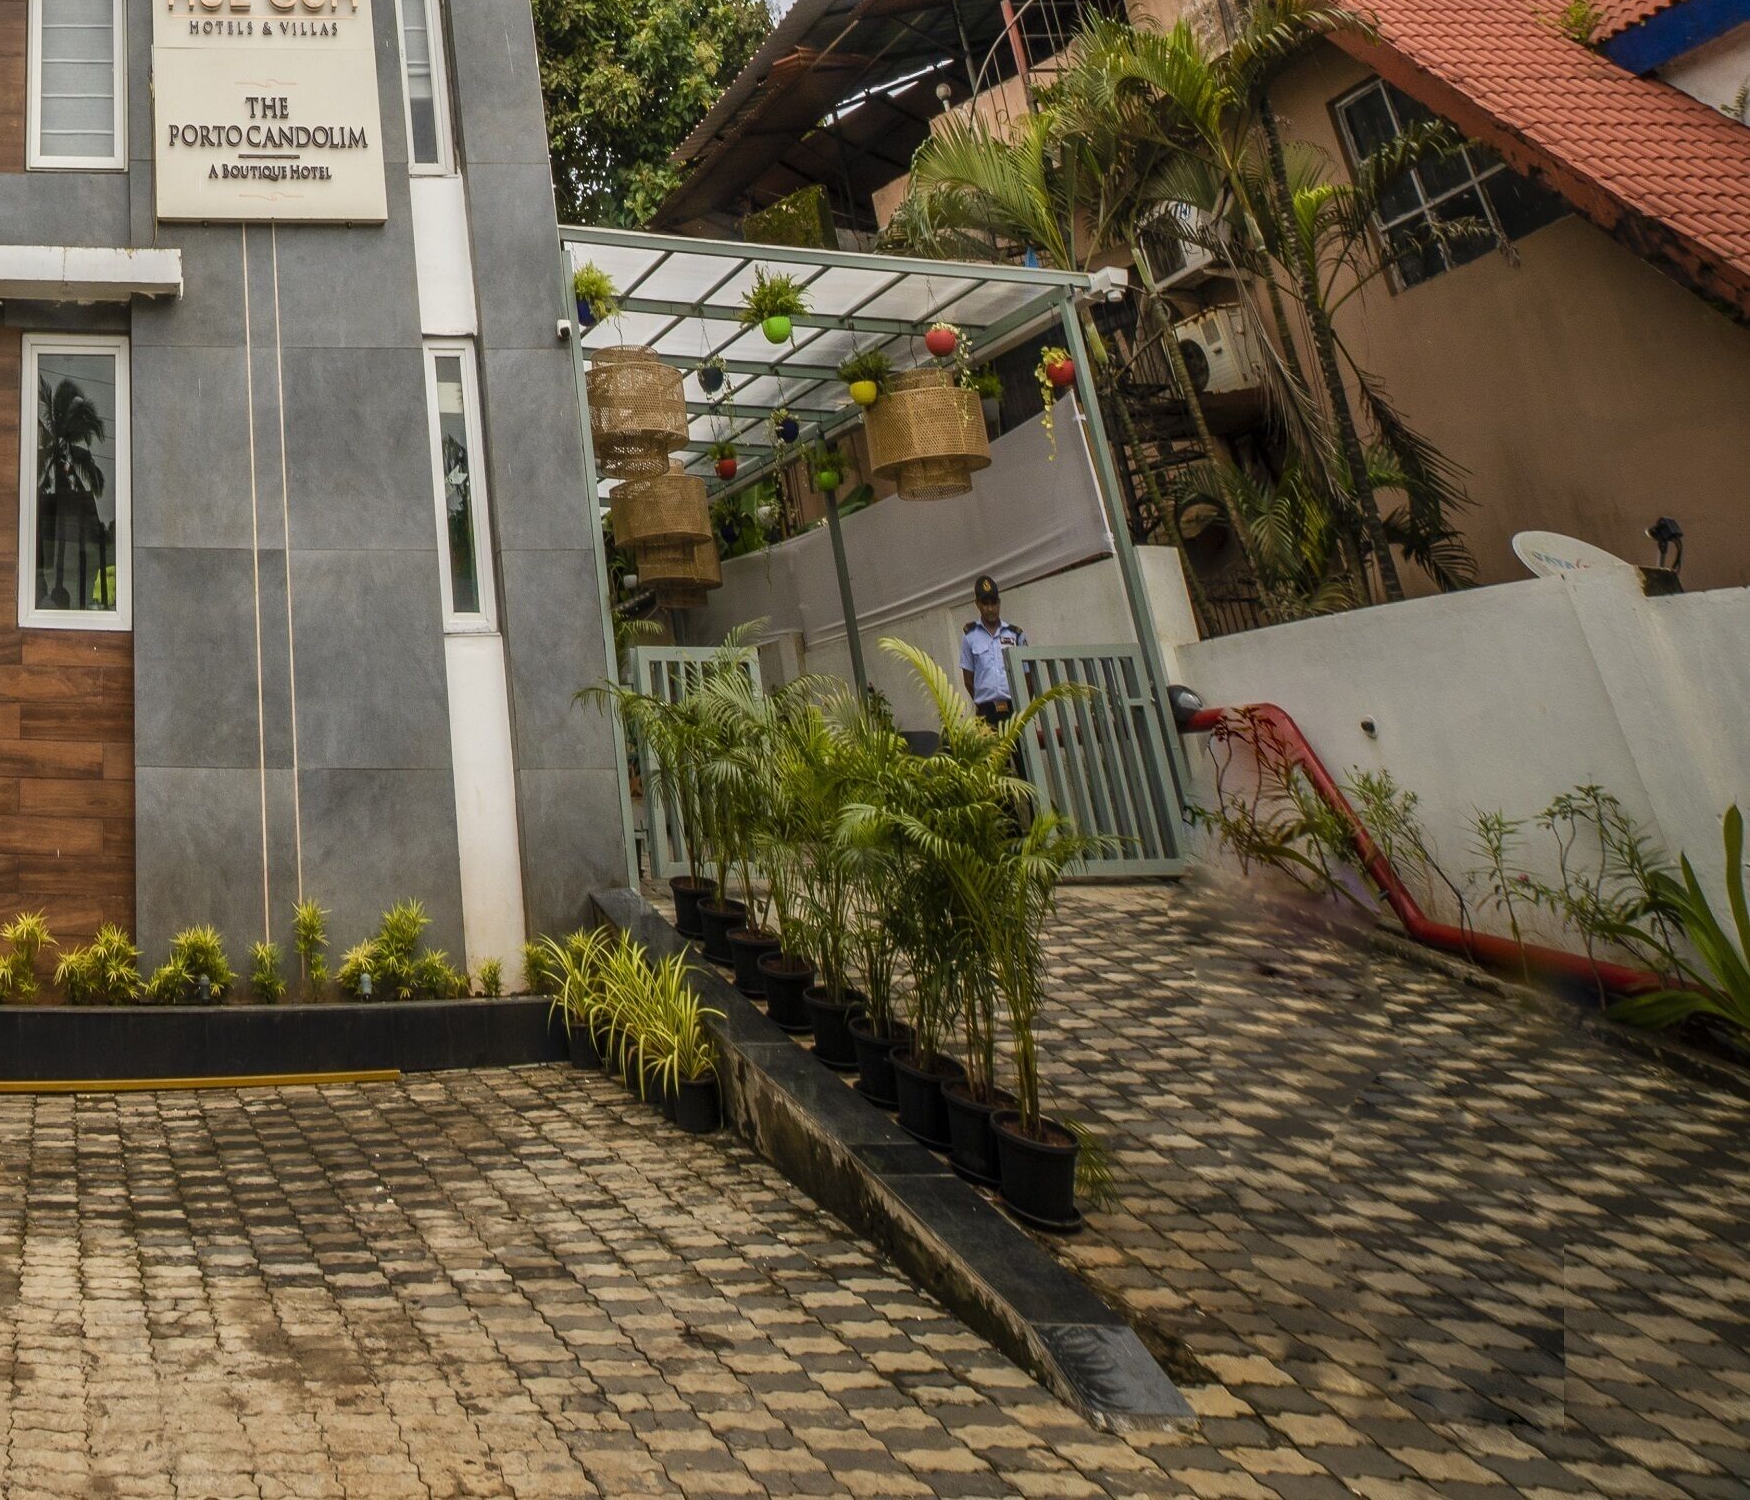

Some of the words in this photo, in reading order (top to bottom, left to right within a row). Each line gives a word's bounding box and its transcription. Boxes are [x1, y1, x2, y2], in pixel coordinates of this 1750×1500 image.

[189, 20, 254, 36] HOTELS
[262, 21, 273, 36] &
[280, 21, 339, 37] VILLAS
[245, 96, 290, 120] THE
[168, 124, 243, 148] PORTO
[246, 125, 369, 149] CANDOLIM
[208, 164, 219, 180] A
